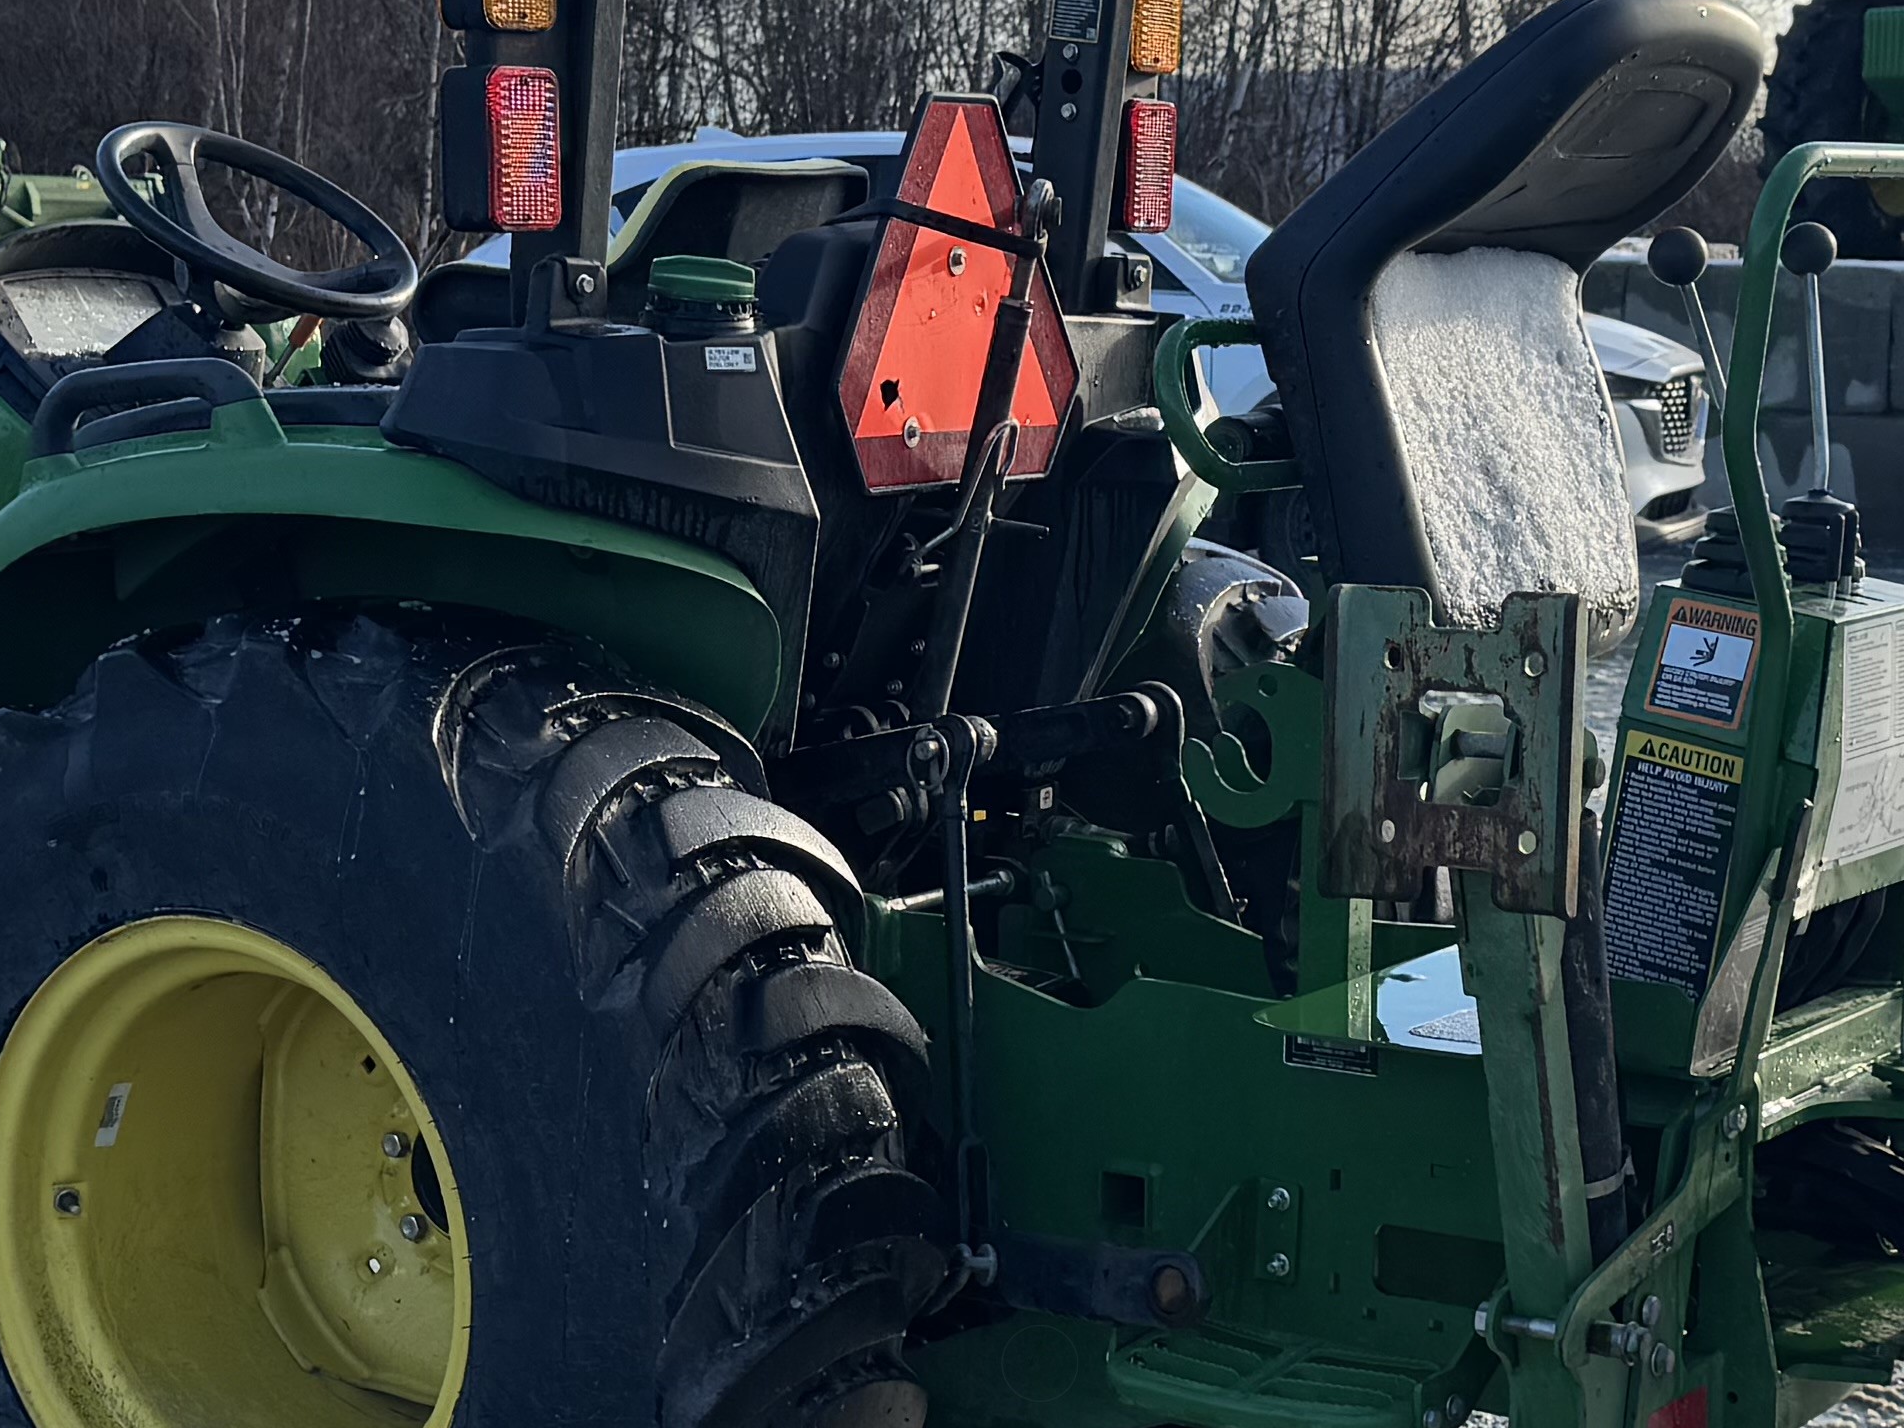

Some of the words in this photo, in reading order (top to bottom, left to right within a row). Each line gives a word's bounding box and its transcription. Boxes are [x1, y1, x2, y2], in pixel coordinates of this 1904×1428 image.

[1689, 606, 1758, 637] WARNING
[1657, 741, 1736, 779] CAUTION
[1637, 761, 1662, 776] HELP
[1663, 767, 1693, 783] AVOID
[1694, 776, 1730, 793] INJURY
